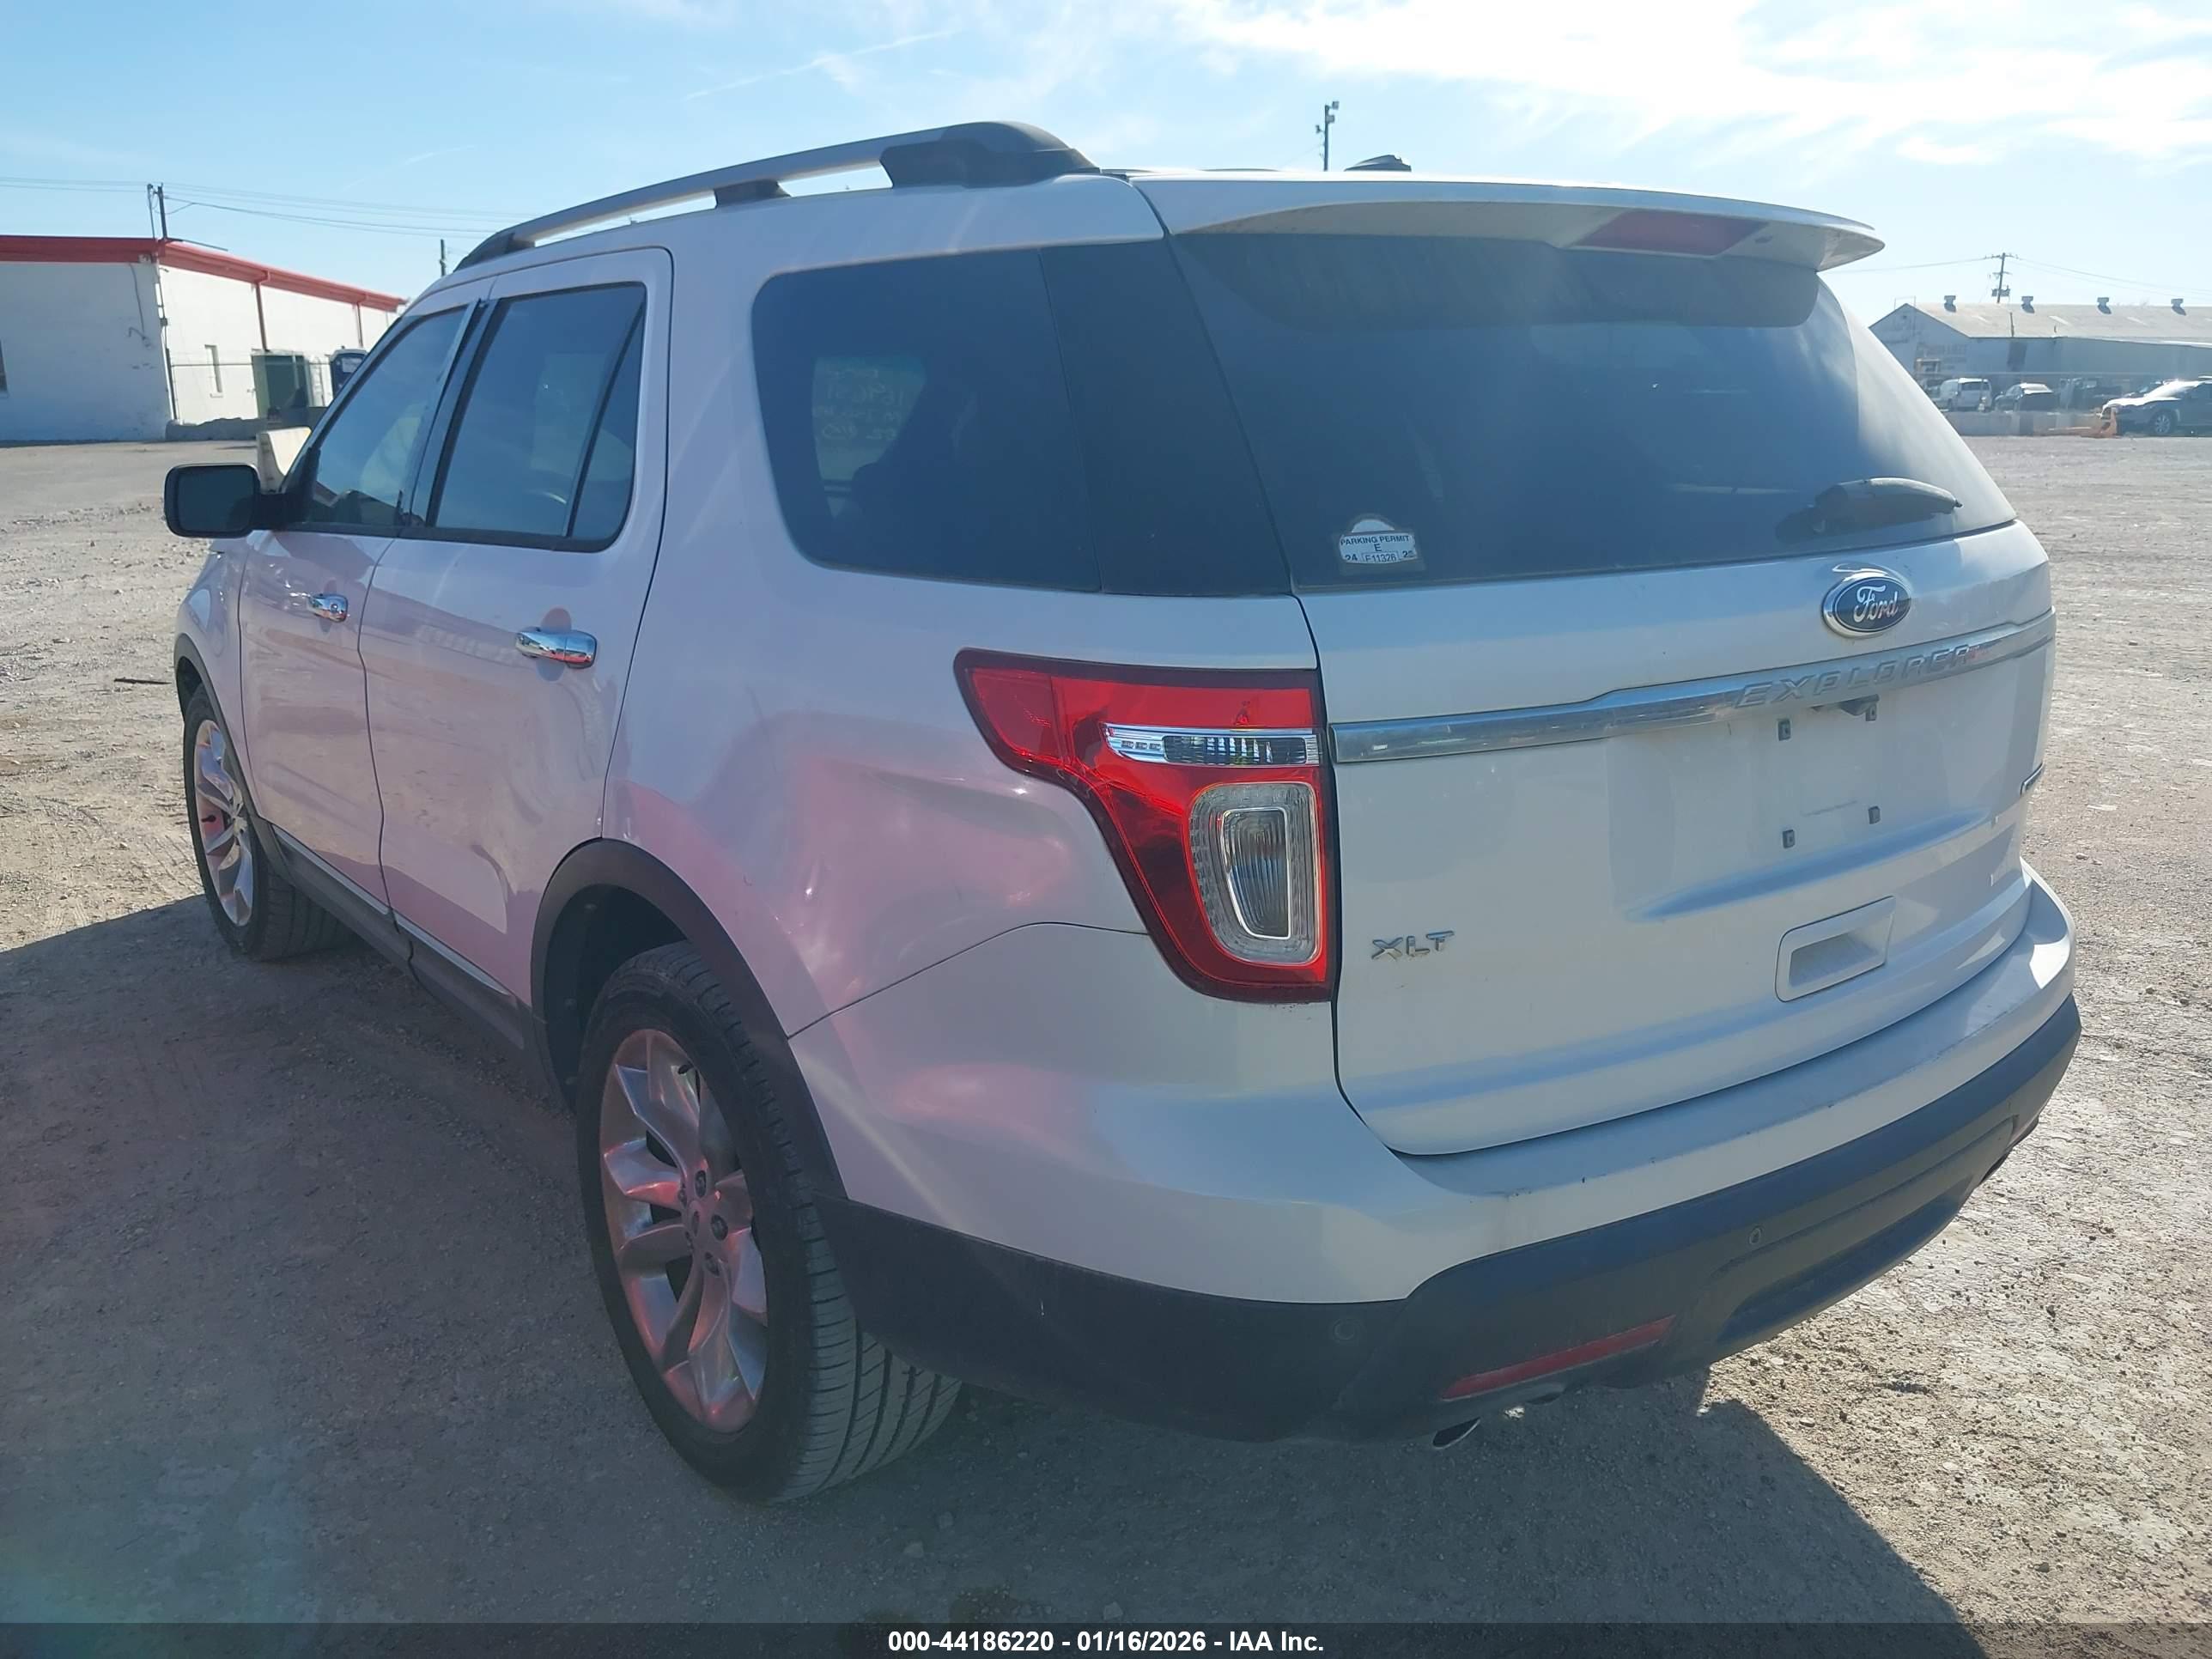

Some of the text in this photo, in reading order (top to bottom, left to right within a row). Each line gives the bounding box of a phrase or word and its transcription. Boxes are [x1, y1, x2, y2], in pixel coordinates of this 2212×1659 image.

[1340, 534, 1410, 546] PARKING PERMIT
[1374, 544, 1382, 552] E
[1853, 585, 1898, 623] Ford
[1734, 643, 1972, 708] EXPLORER
[1371, 930, 1455, 961] XLT
